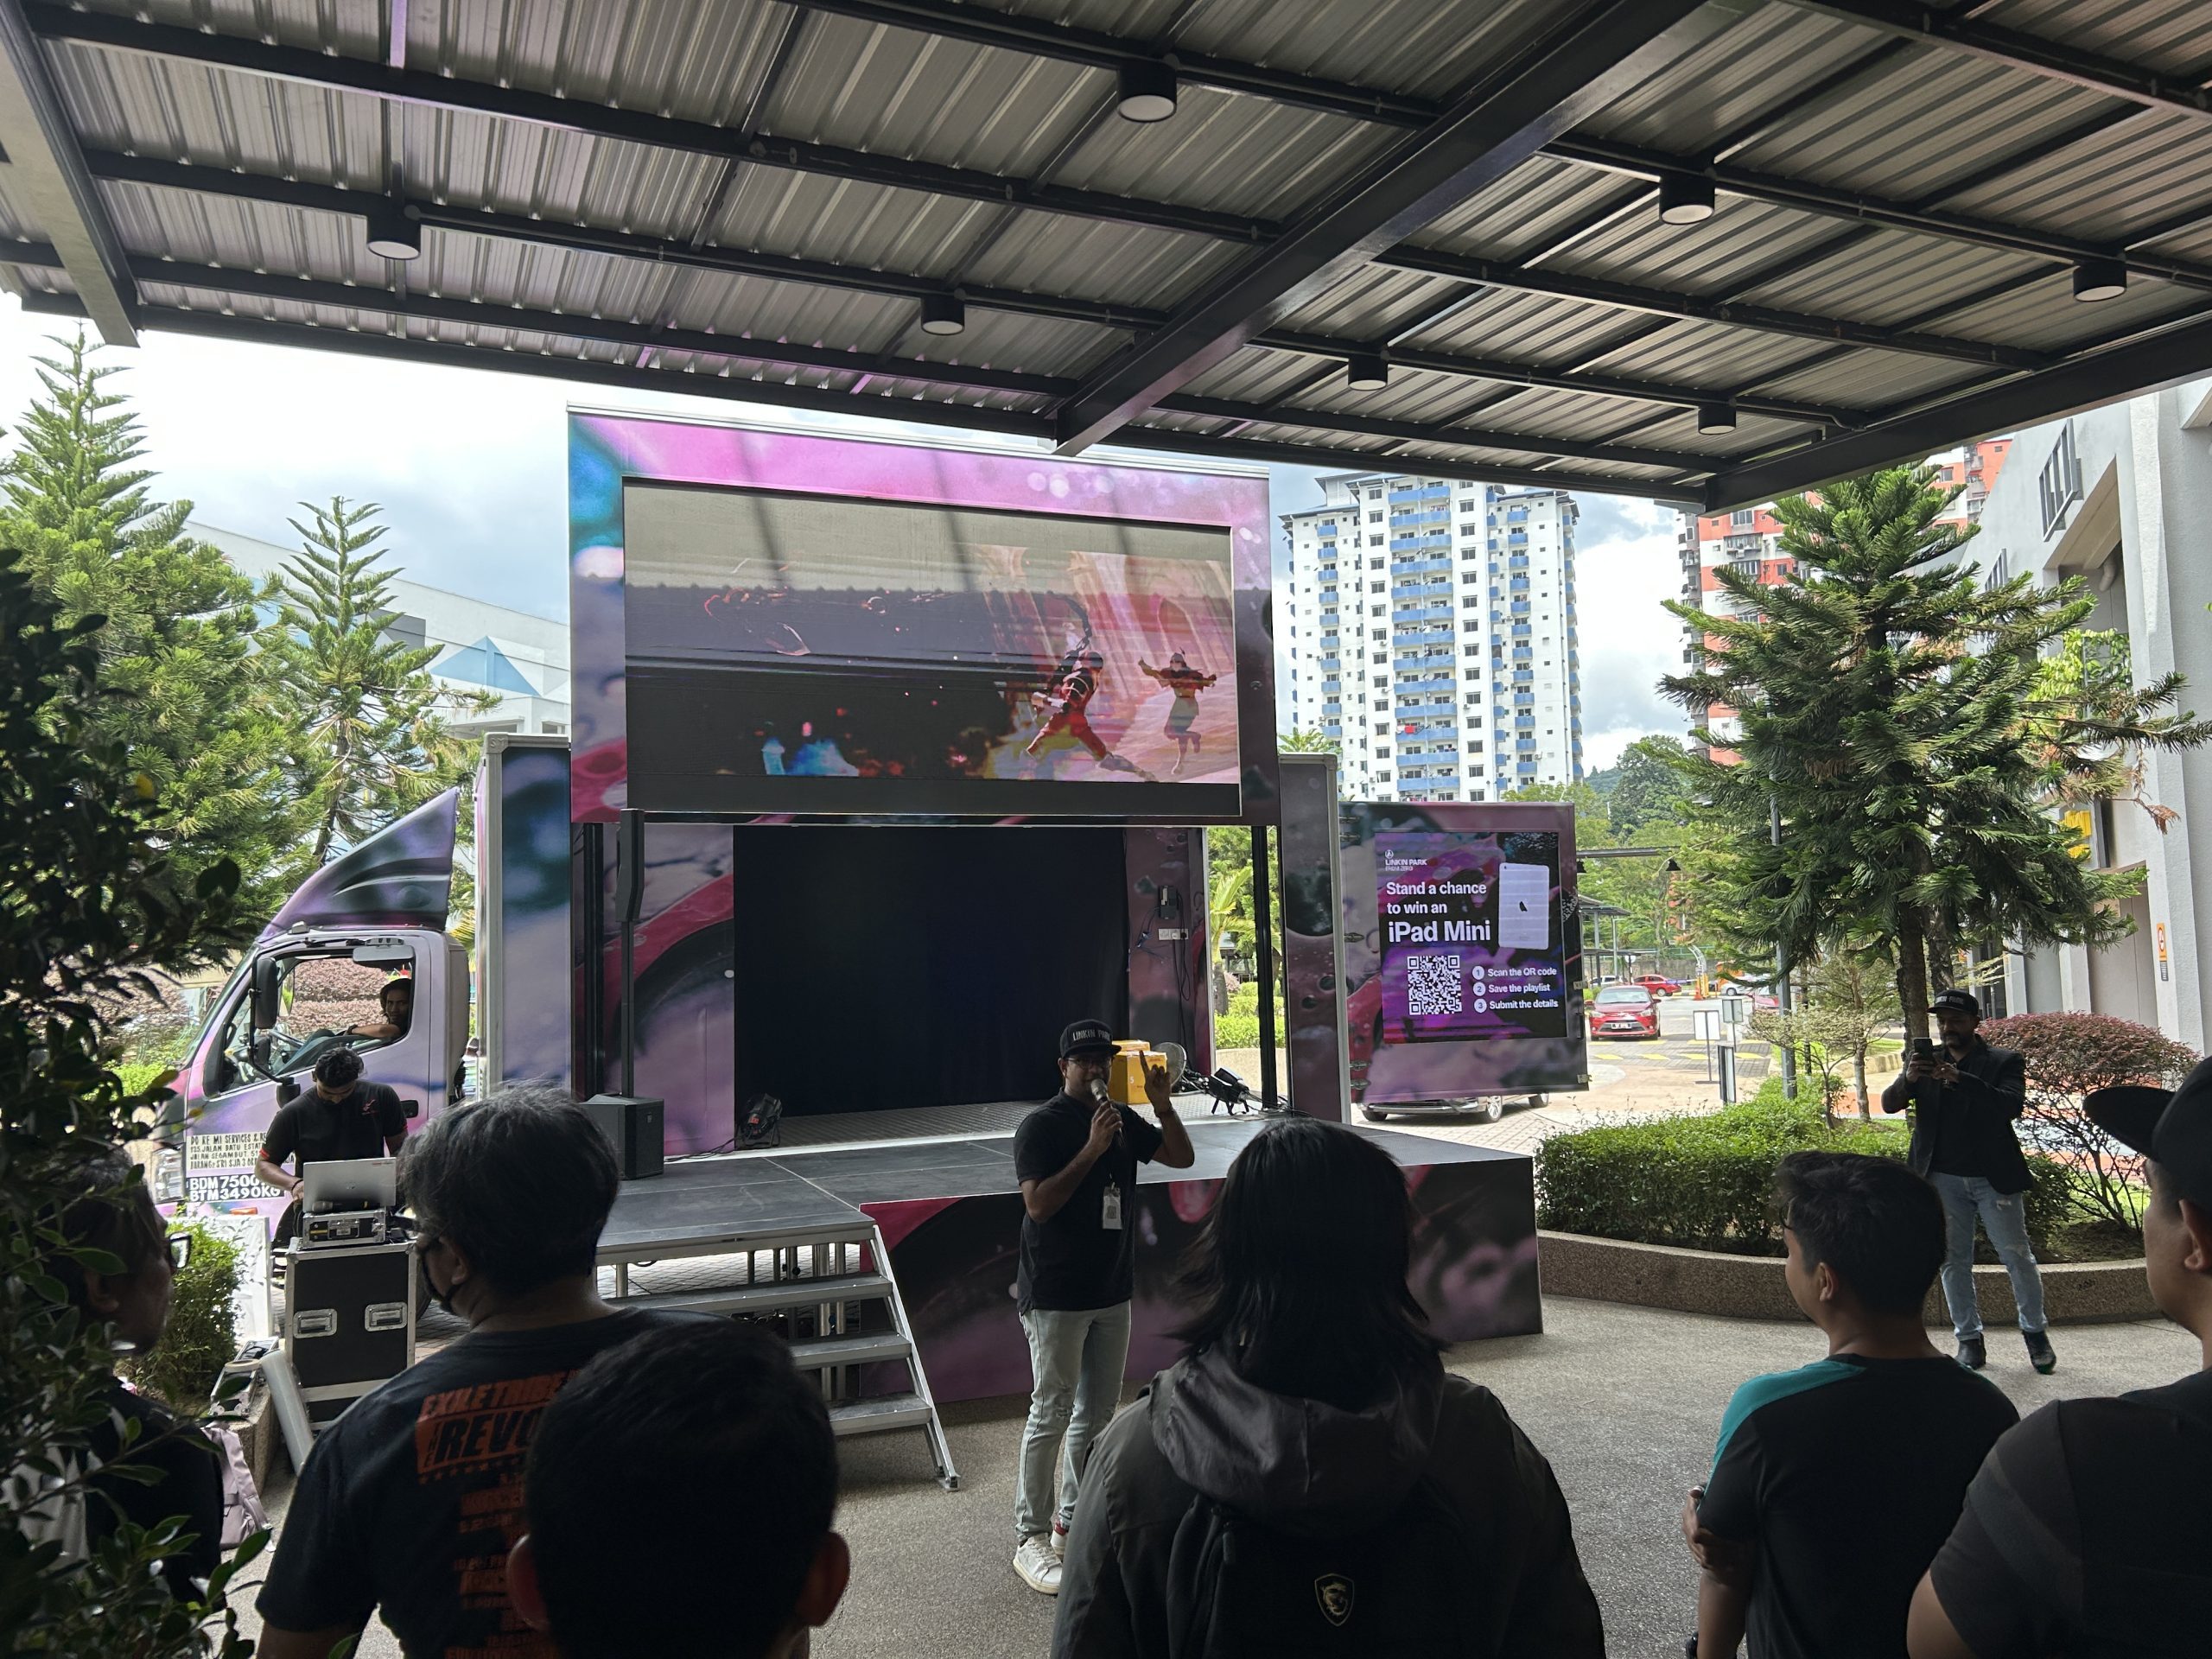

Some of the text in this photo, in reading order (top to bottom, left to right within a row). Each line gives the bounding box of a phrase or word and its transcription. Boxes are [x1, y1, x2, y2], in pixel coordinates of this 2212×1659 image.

[1386, 881, 1486, 895] Stand a chance
[1387, 901, 1447, 914] to win an
[1389, 919, 1491, 943] iPad Mini
[1487, 968, 1508, 976] Scan
[1509, 968, 1522, 976] the
[1523, 967, 1536, 976] QR
[1537, 967, 1557, 976] code
[1488, 984, 1508, 993] Save
[1523, 983, 1550, 994] playlist
[1489, 1000, 1518, 1009] Submit
[1519, 1000, 1532, 1008] the
[1533, 999, 1558, 1008] details
[1072, 1029, 1096, 1041] LINKIN
[213, 1135, 222, 1144] MI
[225, 1134, 251, 1143] SERVICES
[190, 1176, 219, 1190] BDM
[190, 1185, 281, 1202] BTM 3490KG
